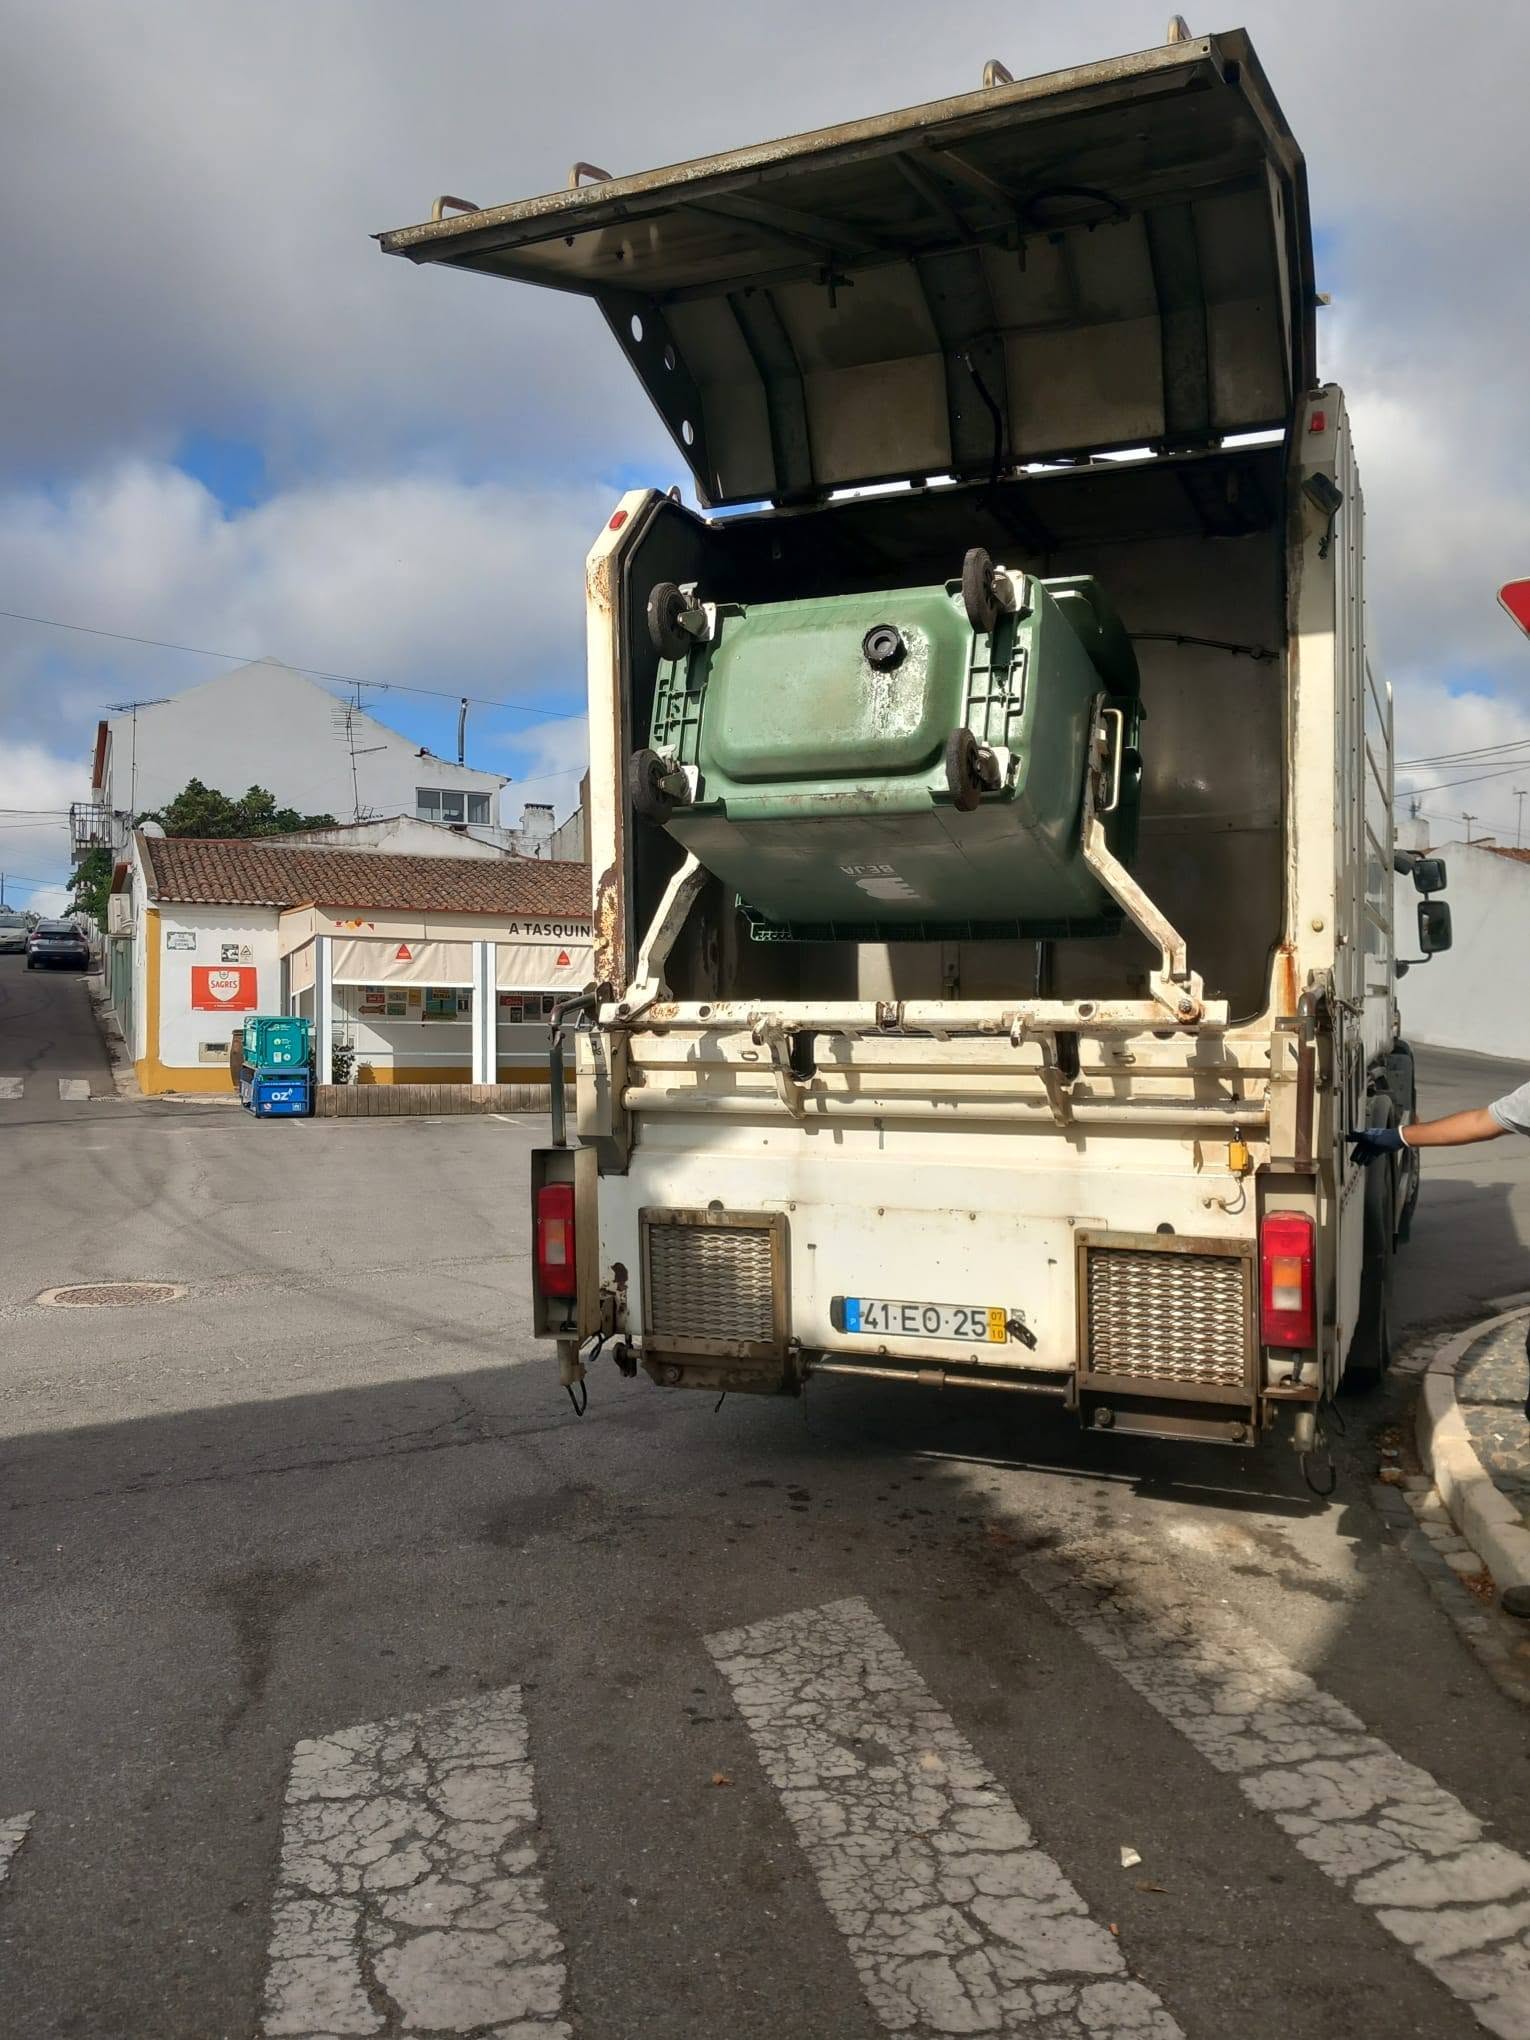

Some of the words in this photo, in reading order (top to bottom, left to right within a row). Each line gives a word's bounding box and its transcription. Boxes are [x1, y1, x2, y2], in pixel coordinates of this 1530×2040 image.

[840, 865, 896, 874] BEJA
[509, 923, 520, 934] A
[524, 923, 593, 938] TASQUIN
[210, 980, 238, 989] SAGRES
[990, 1311, 1003, 1321] 07
[991, 1328, 1003, 1339] 10
